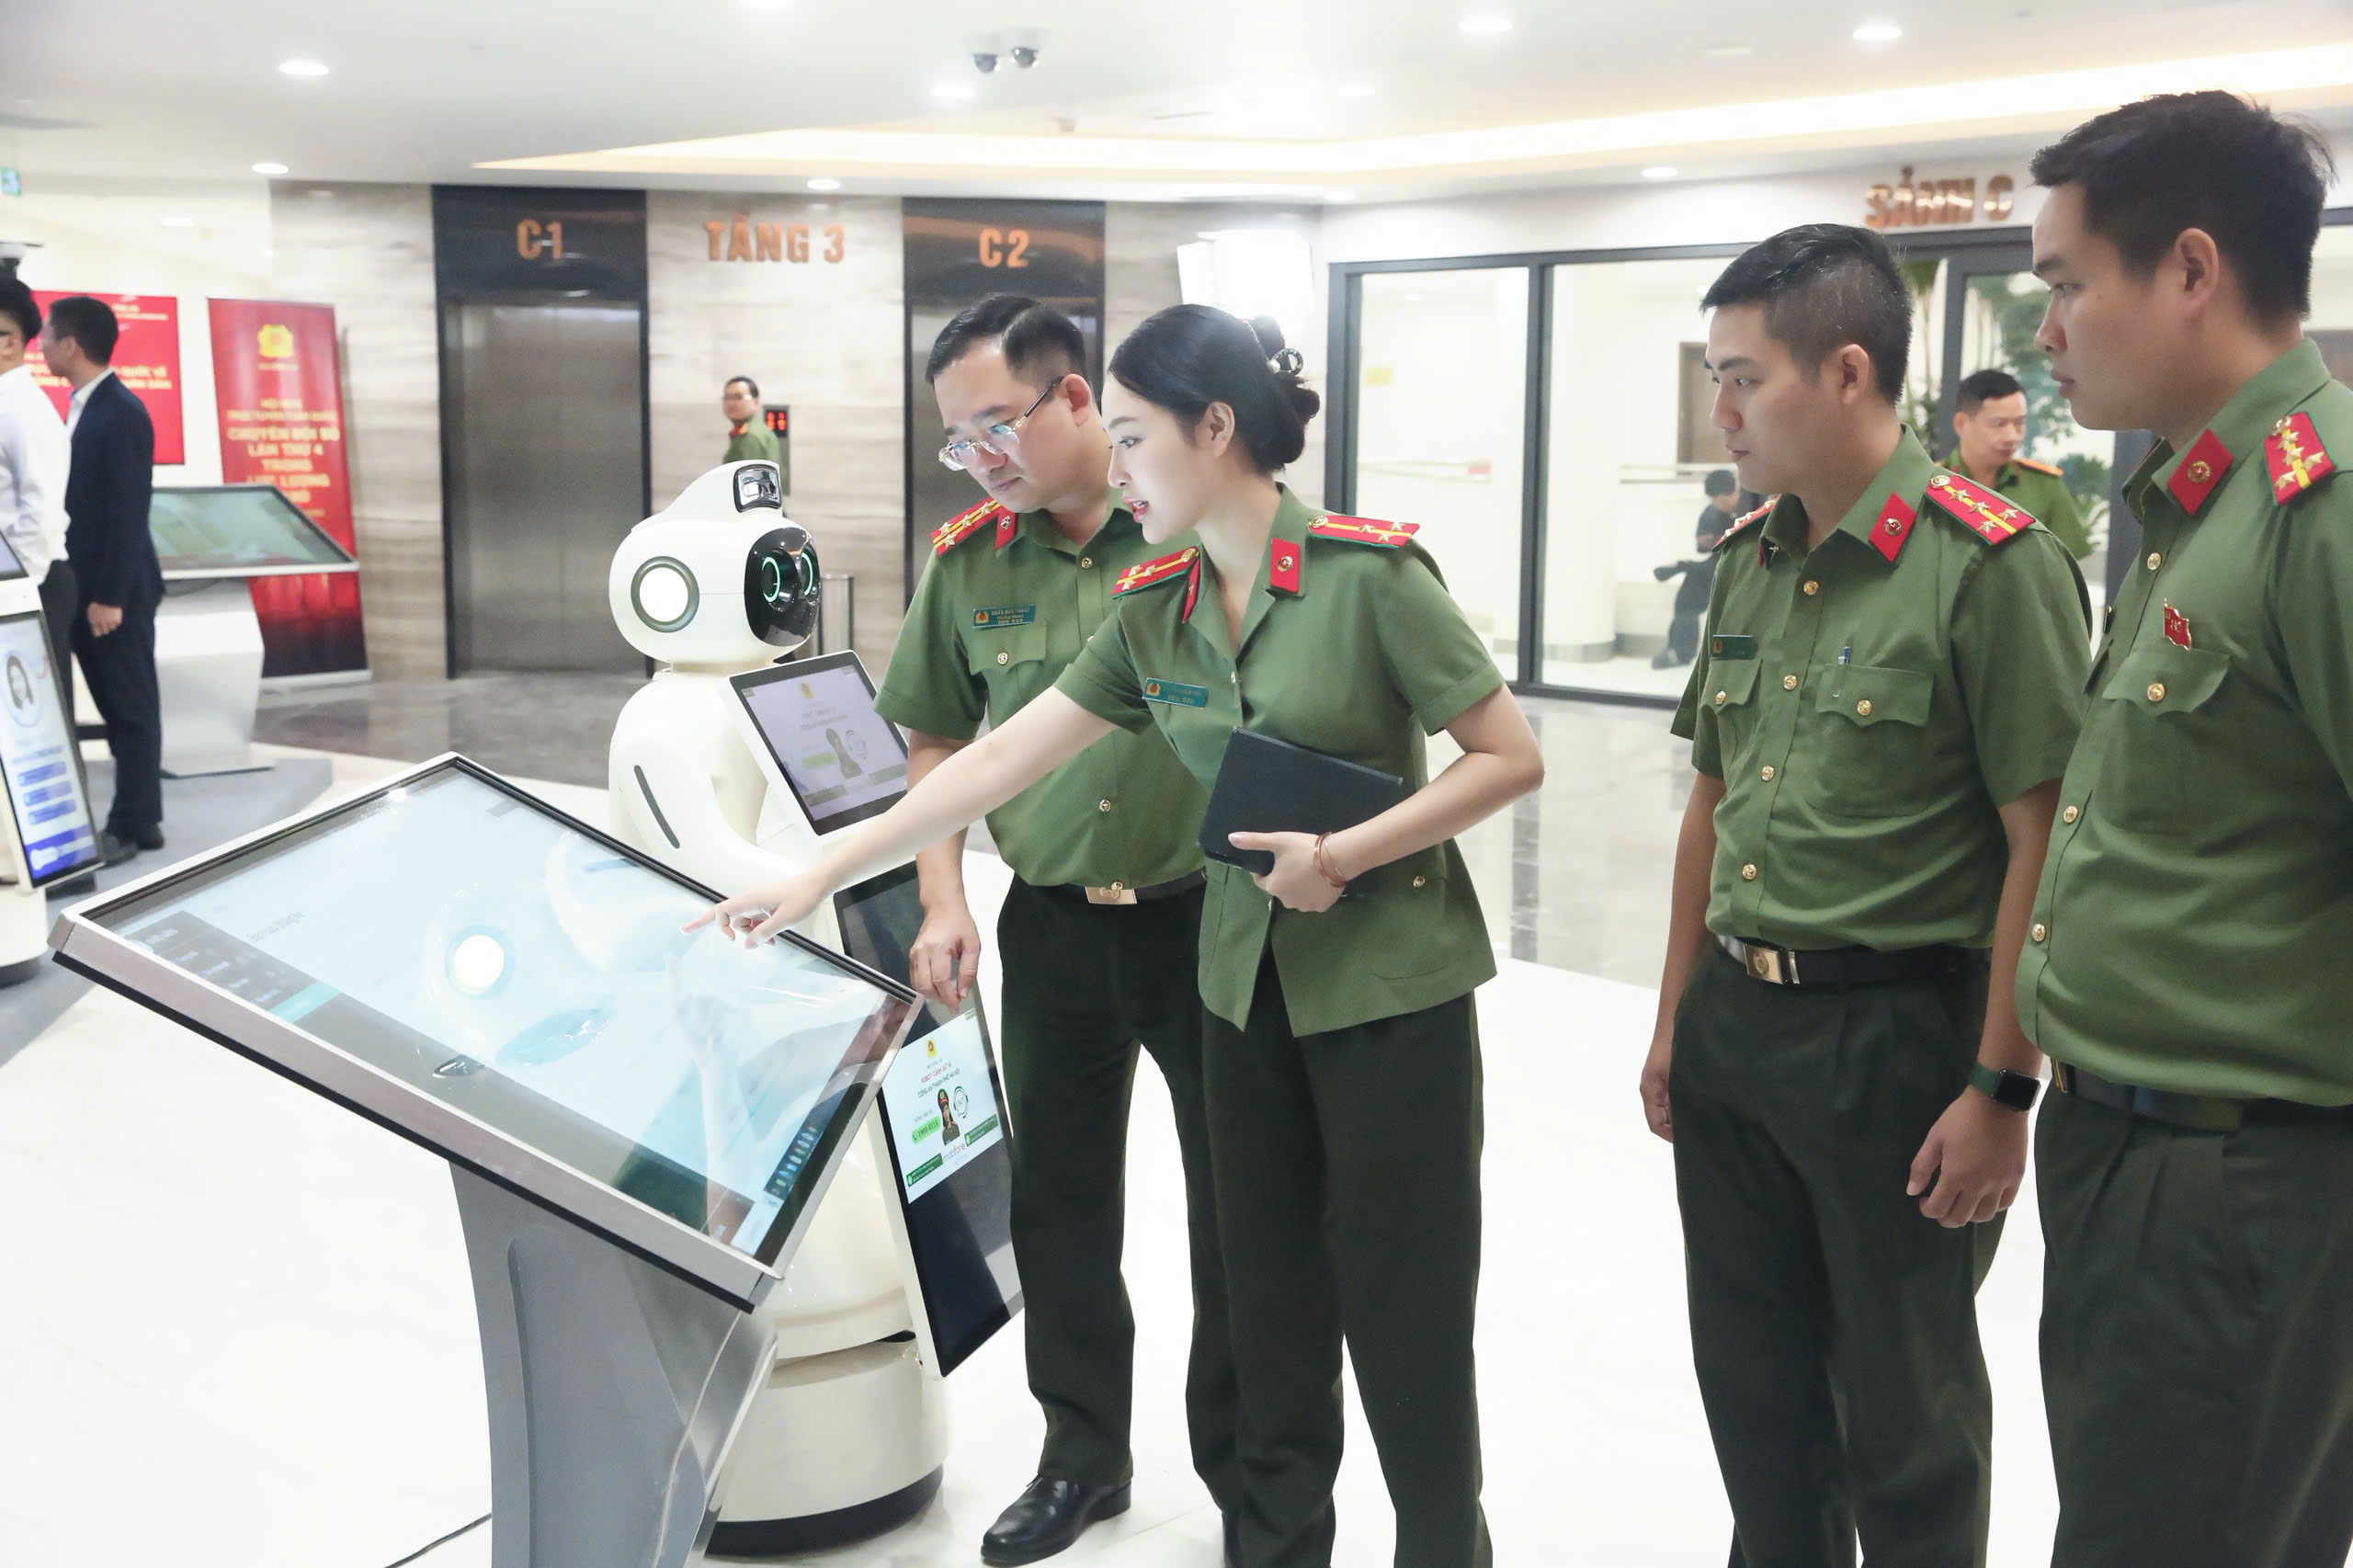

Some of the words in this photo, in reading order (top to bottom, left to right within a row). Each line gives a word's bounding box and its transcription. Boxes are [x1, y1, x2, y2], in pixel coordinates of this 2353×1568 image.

[517, 219, 563, 259] C1
[824, 223, 845, 263] 3
[979, 228, 1029, 267] C2
